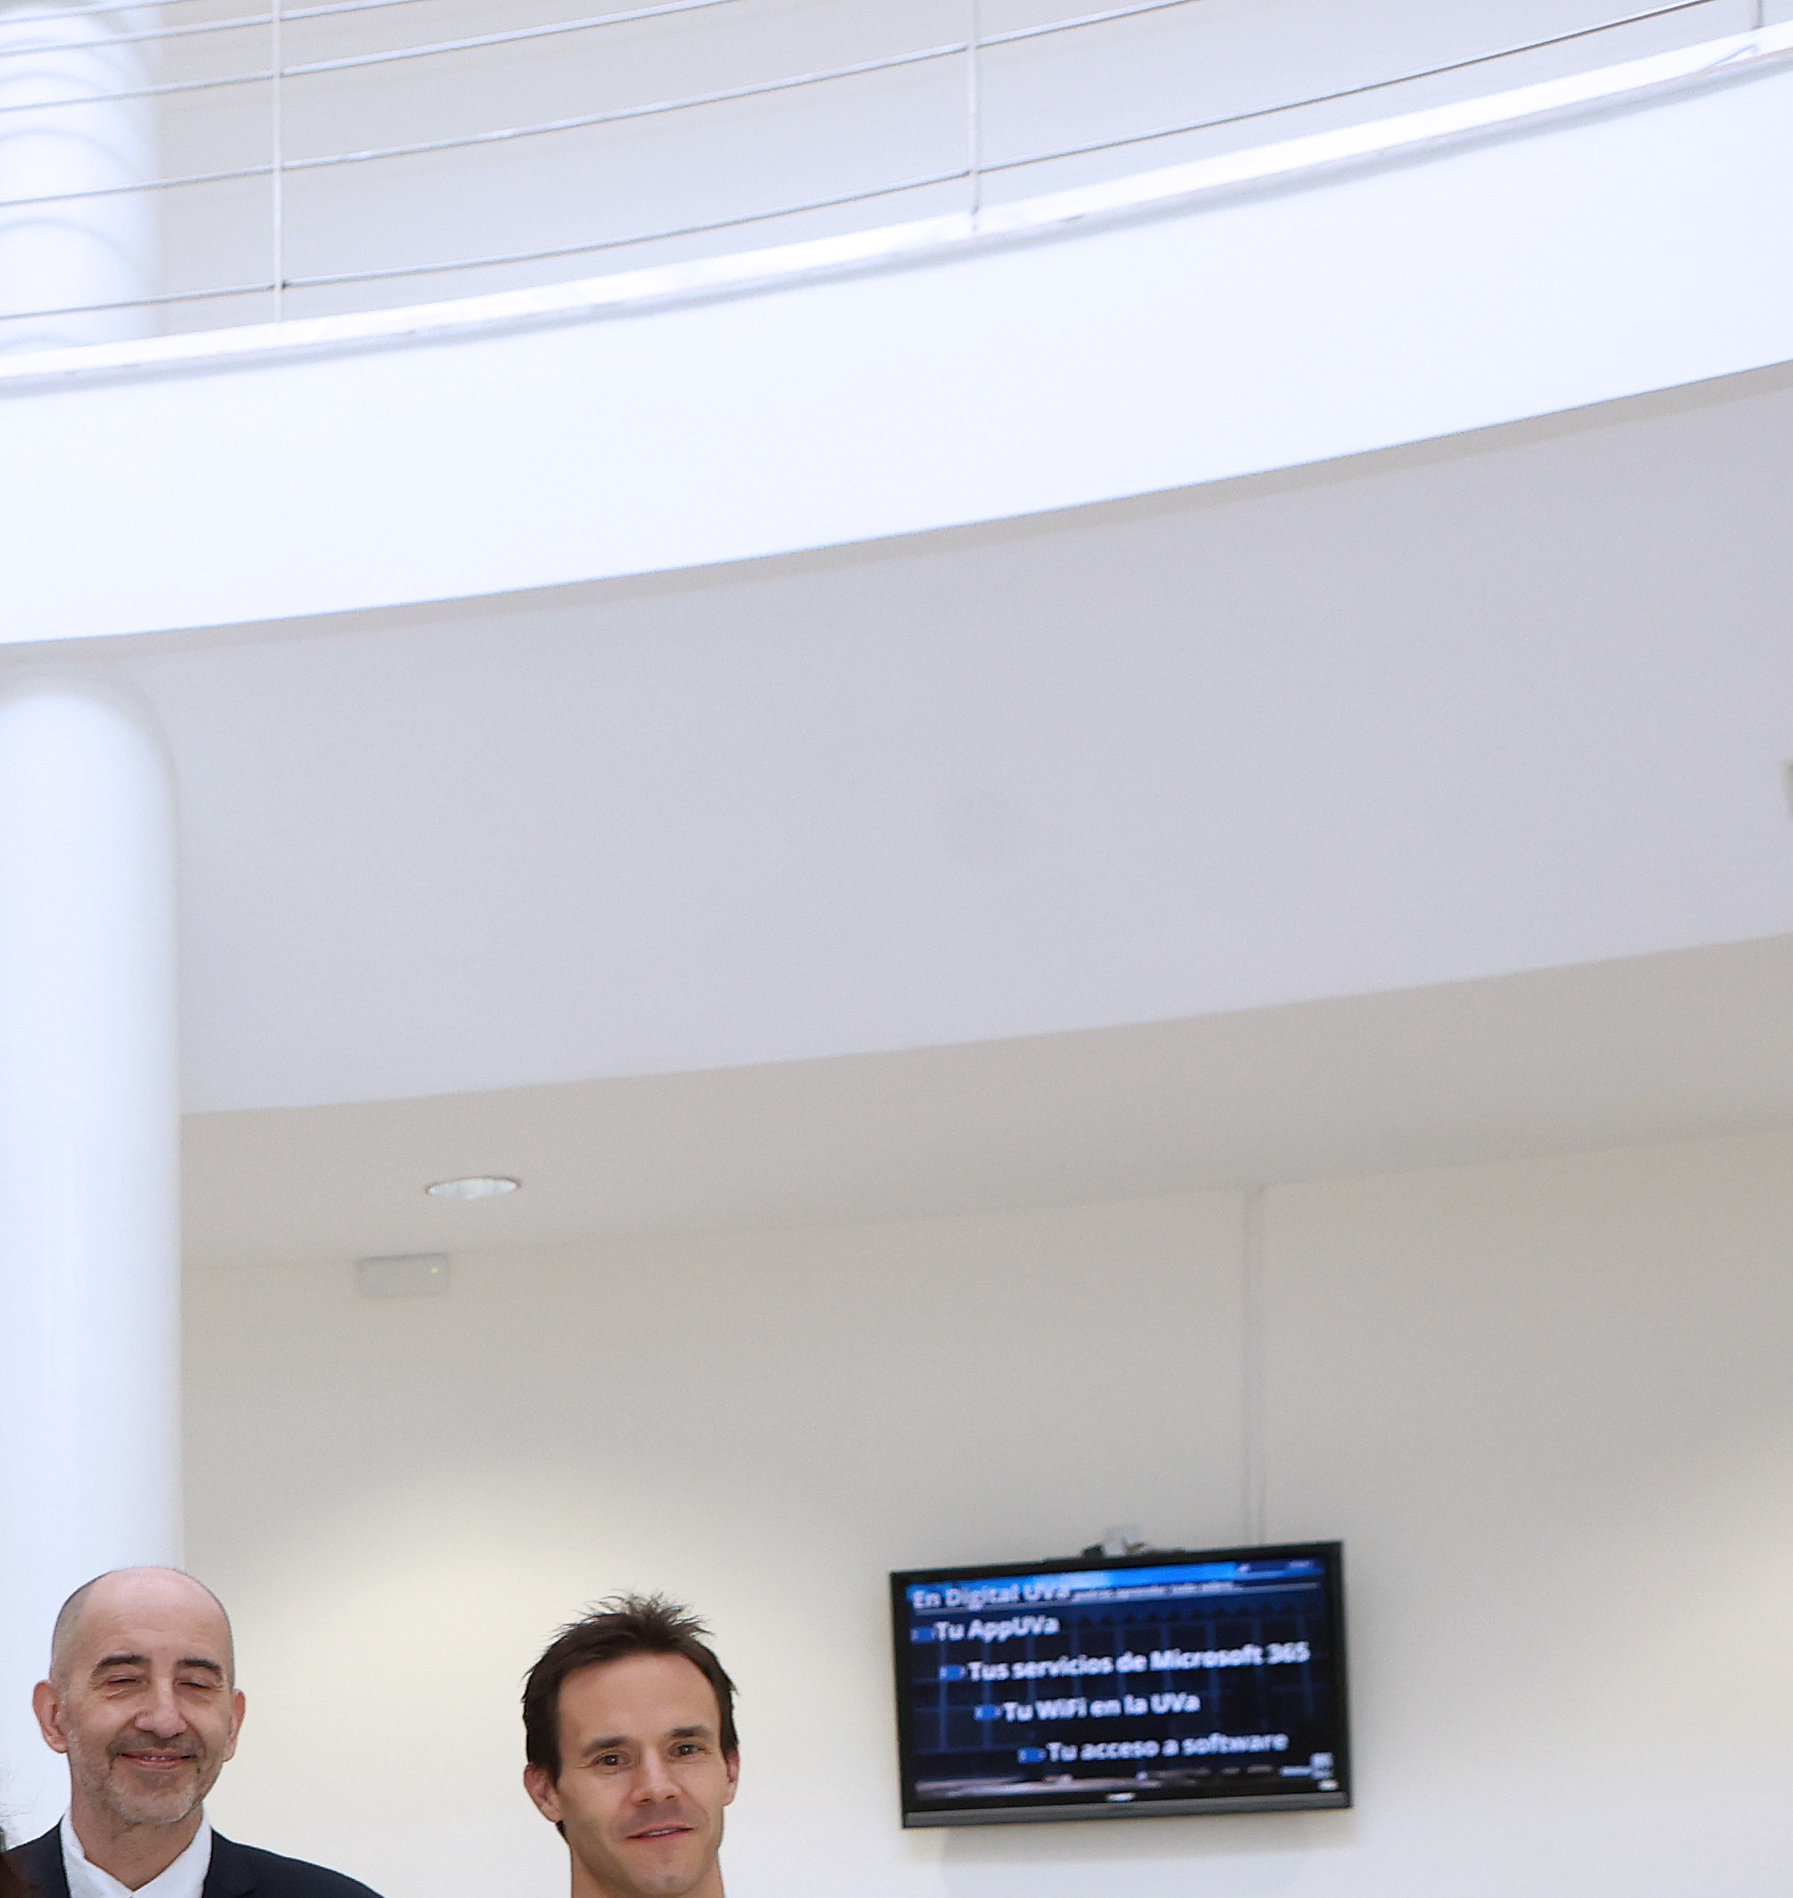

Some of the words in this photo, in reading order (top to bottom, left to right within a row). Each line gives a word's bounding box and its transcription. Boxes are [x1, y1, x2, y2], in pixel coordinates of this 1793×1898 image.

[913, 1589, 941, 1609] En
[934, 1621, 965, 1641] Tu
[967, 1614, 1061, 1644] AppUVa
[967, 1660, 1009, 1681] Tus
[1011, 1654, 1114, 1680] servicios
[1115, 1651, 1147, 1674] de
[1149, 1643, 1263, 1672] Microsoft
[1266, 1641, 1311, 1664] 365
[1003, 1700, 1034, 1722] Tu
[1089, 1698, 1122, 1719] en
[1124, 1694, 1149, 1716] la
[1150, 1691, 1201, 1714] UVa
[1045, 1741, 1078, 1762] Tu
[1080, 1740, 1160, 1762] acceso
[1162, 1738, 1180, 1757] a
[1181, 1732, 1289, 1758] software
